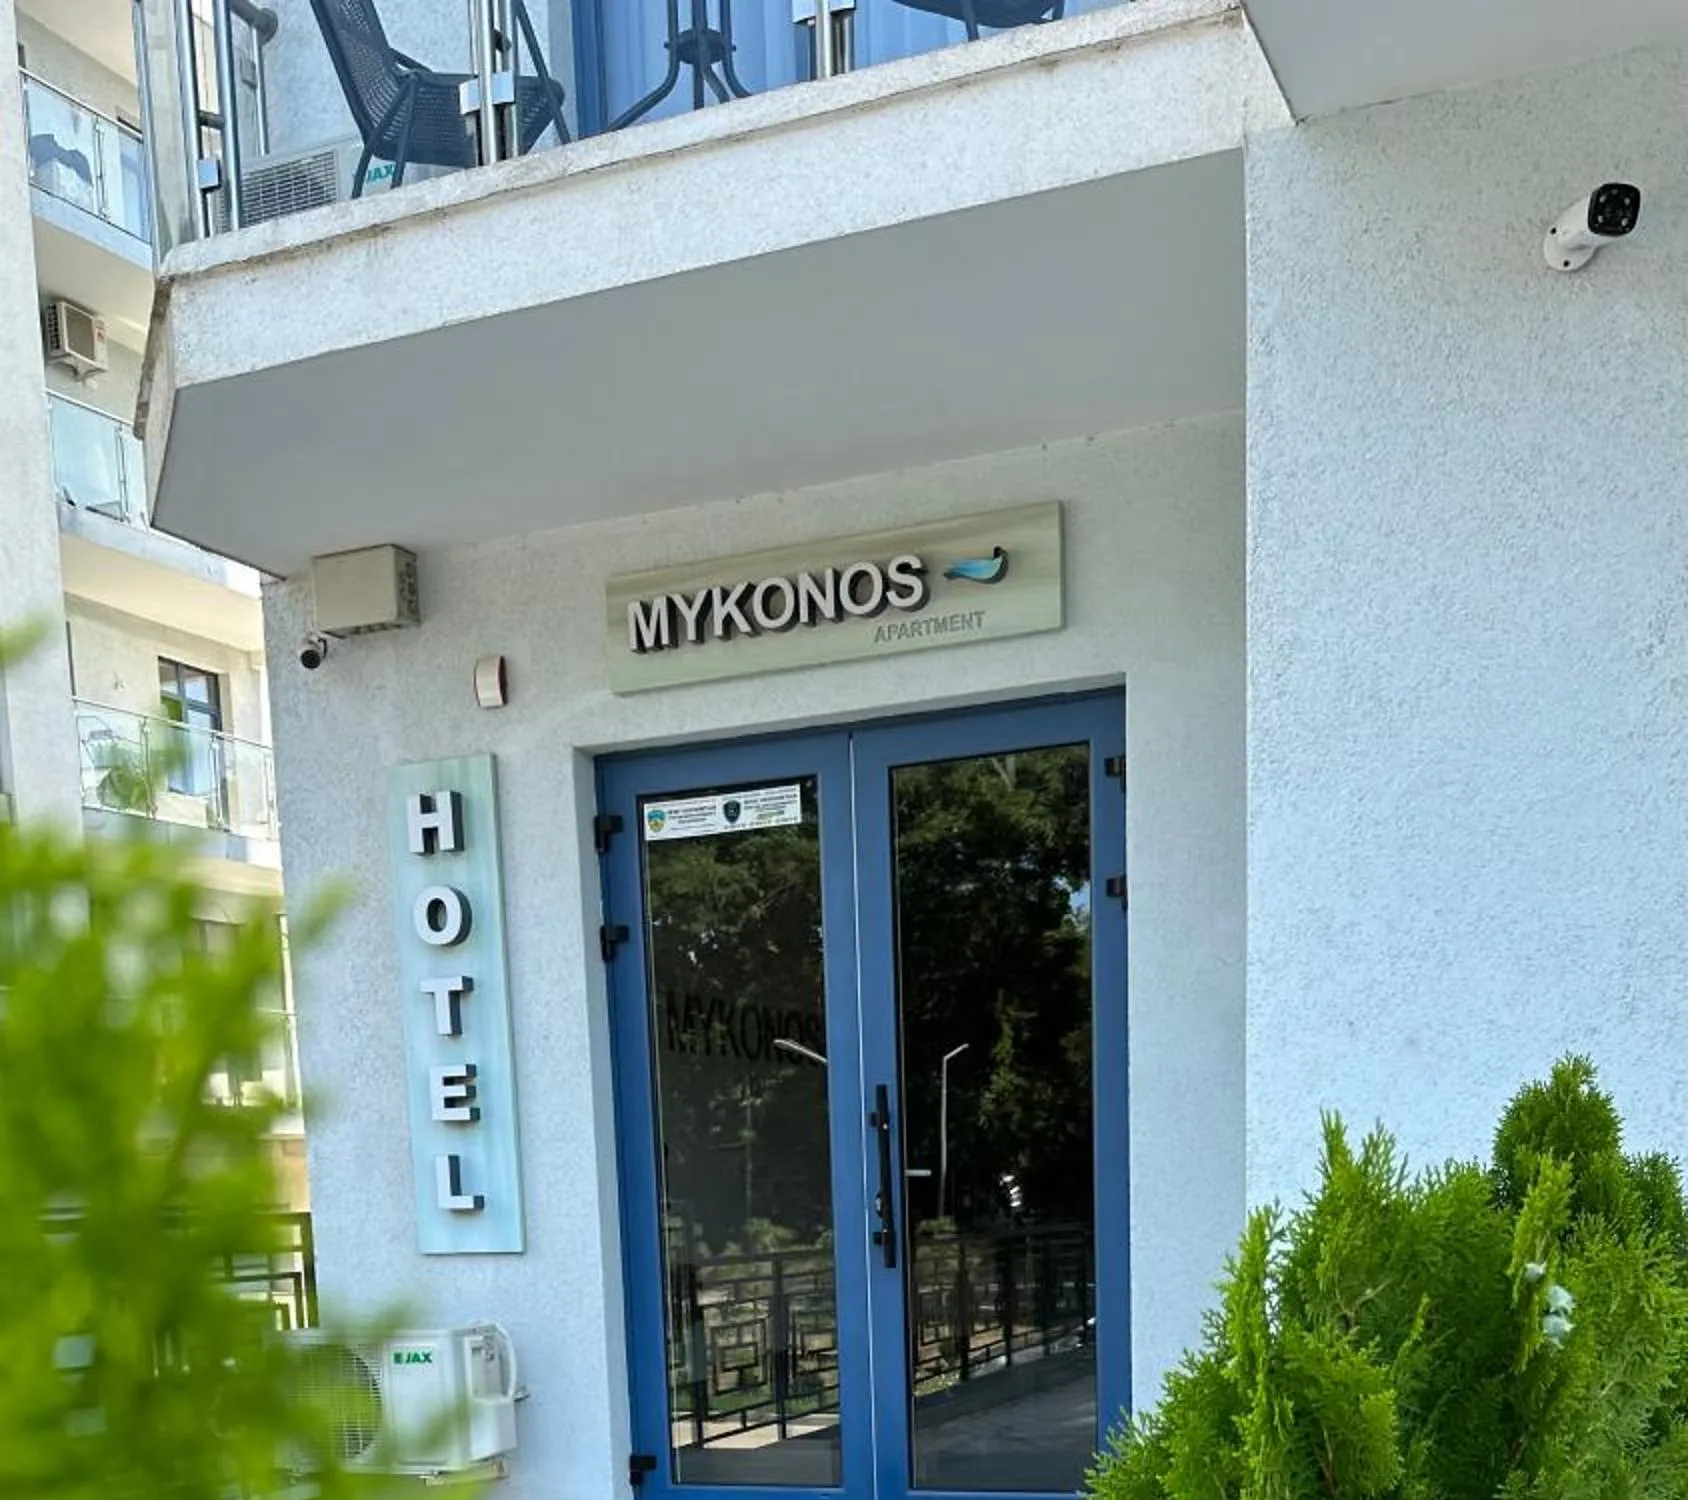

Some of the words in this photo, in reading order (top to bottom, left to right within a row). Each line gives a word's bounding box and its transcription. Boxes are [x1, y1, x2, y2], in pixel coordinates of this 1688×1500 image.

[626, 553, 926, 652] MYKONOS
[873, 610, 986, 643] APARTMENT
[407, 789, 483, 1210] HOTEL
